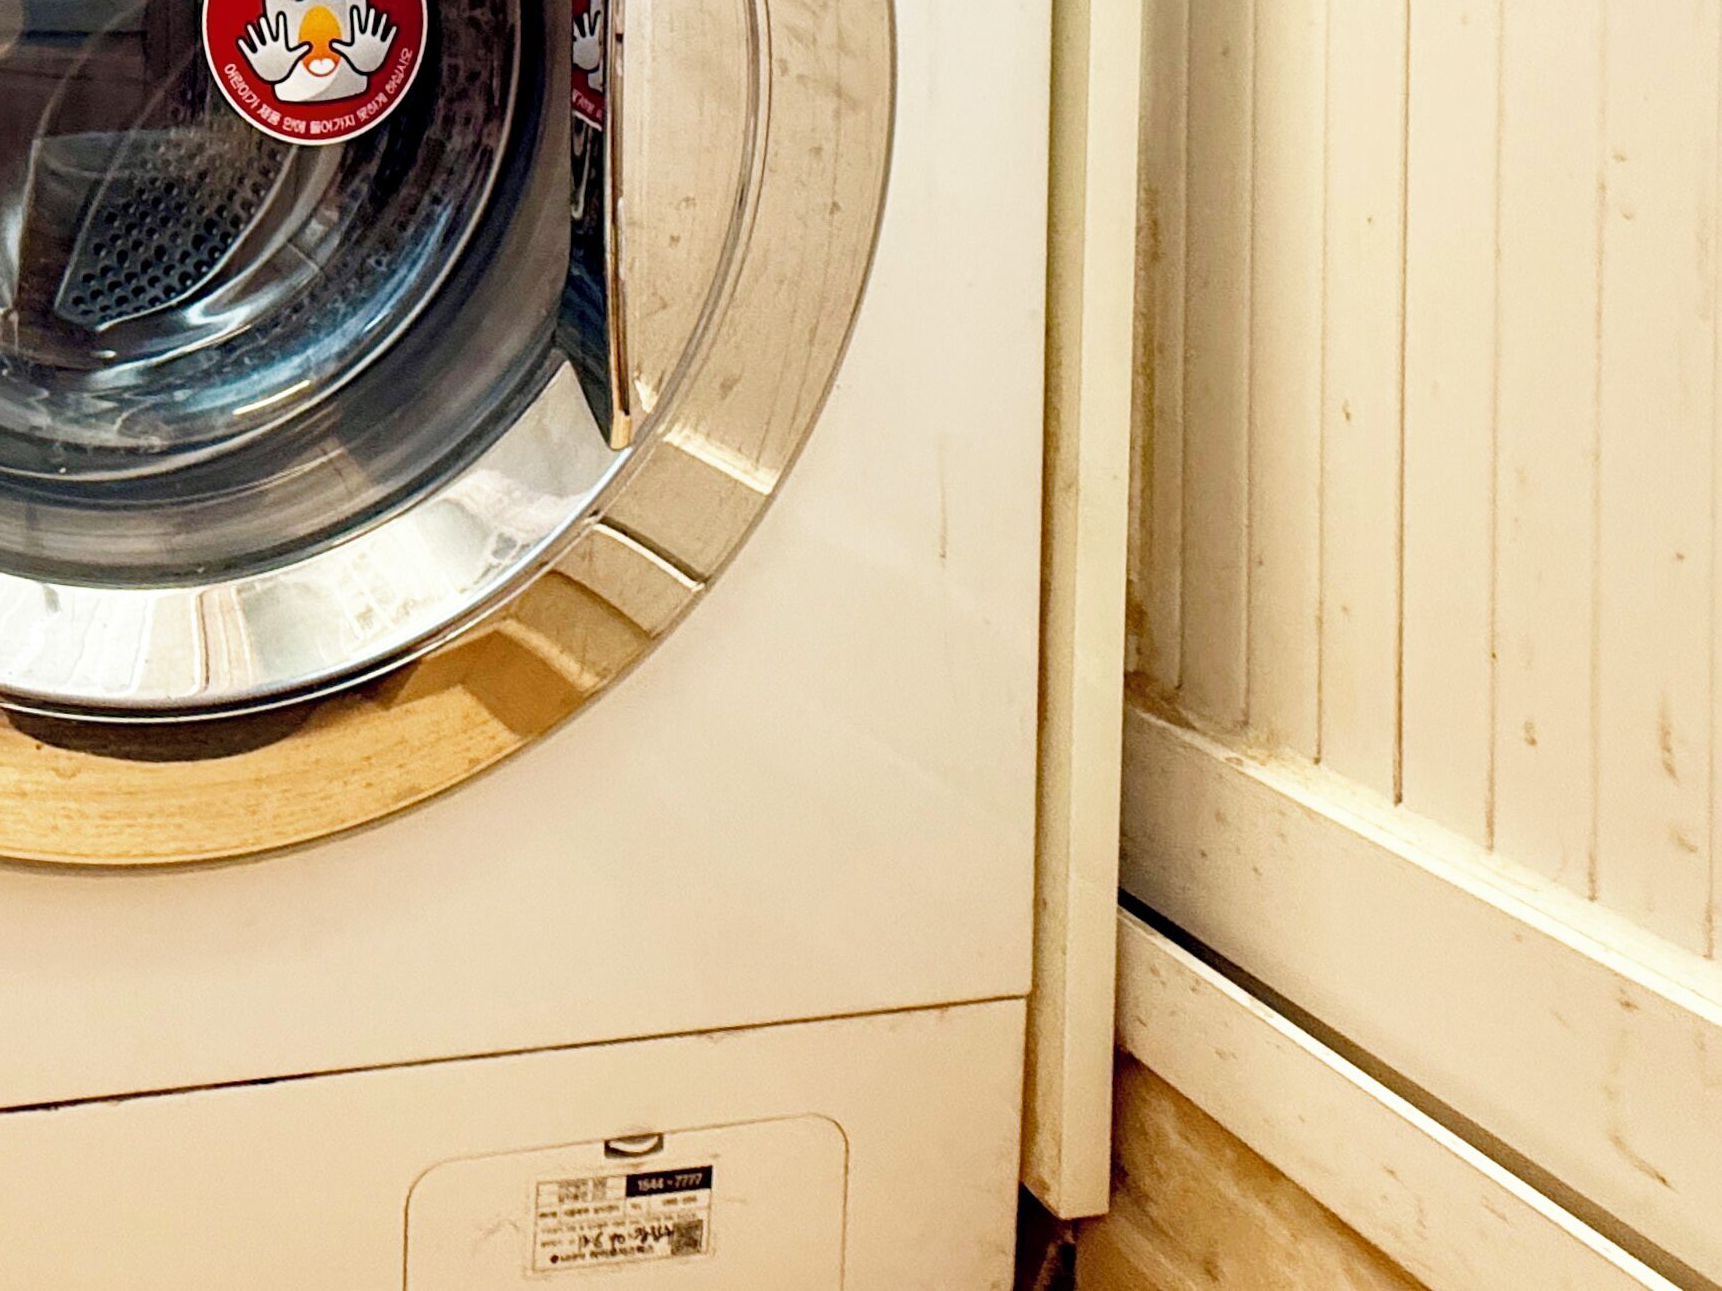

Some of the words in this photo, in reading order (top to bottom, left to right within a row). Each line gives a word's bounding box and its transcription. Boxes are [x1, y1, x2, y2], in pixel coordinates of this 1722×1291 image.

[223, 62, 261, 110] 어린이가
[282, 116, 307, 135] 안에
[309, 113, 356, 135] 들어가지
